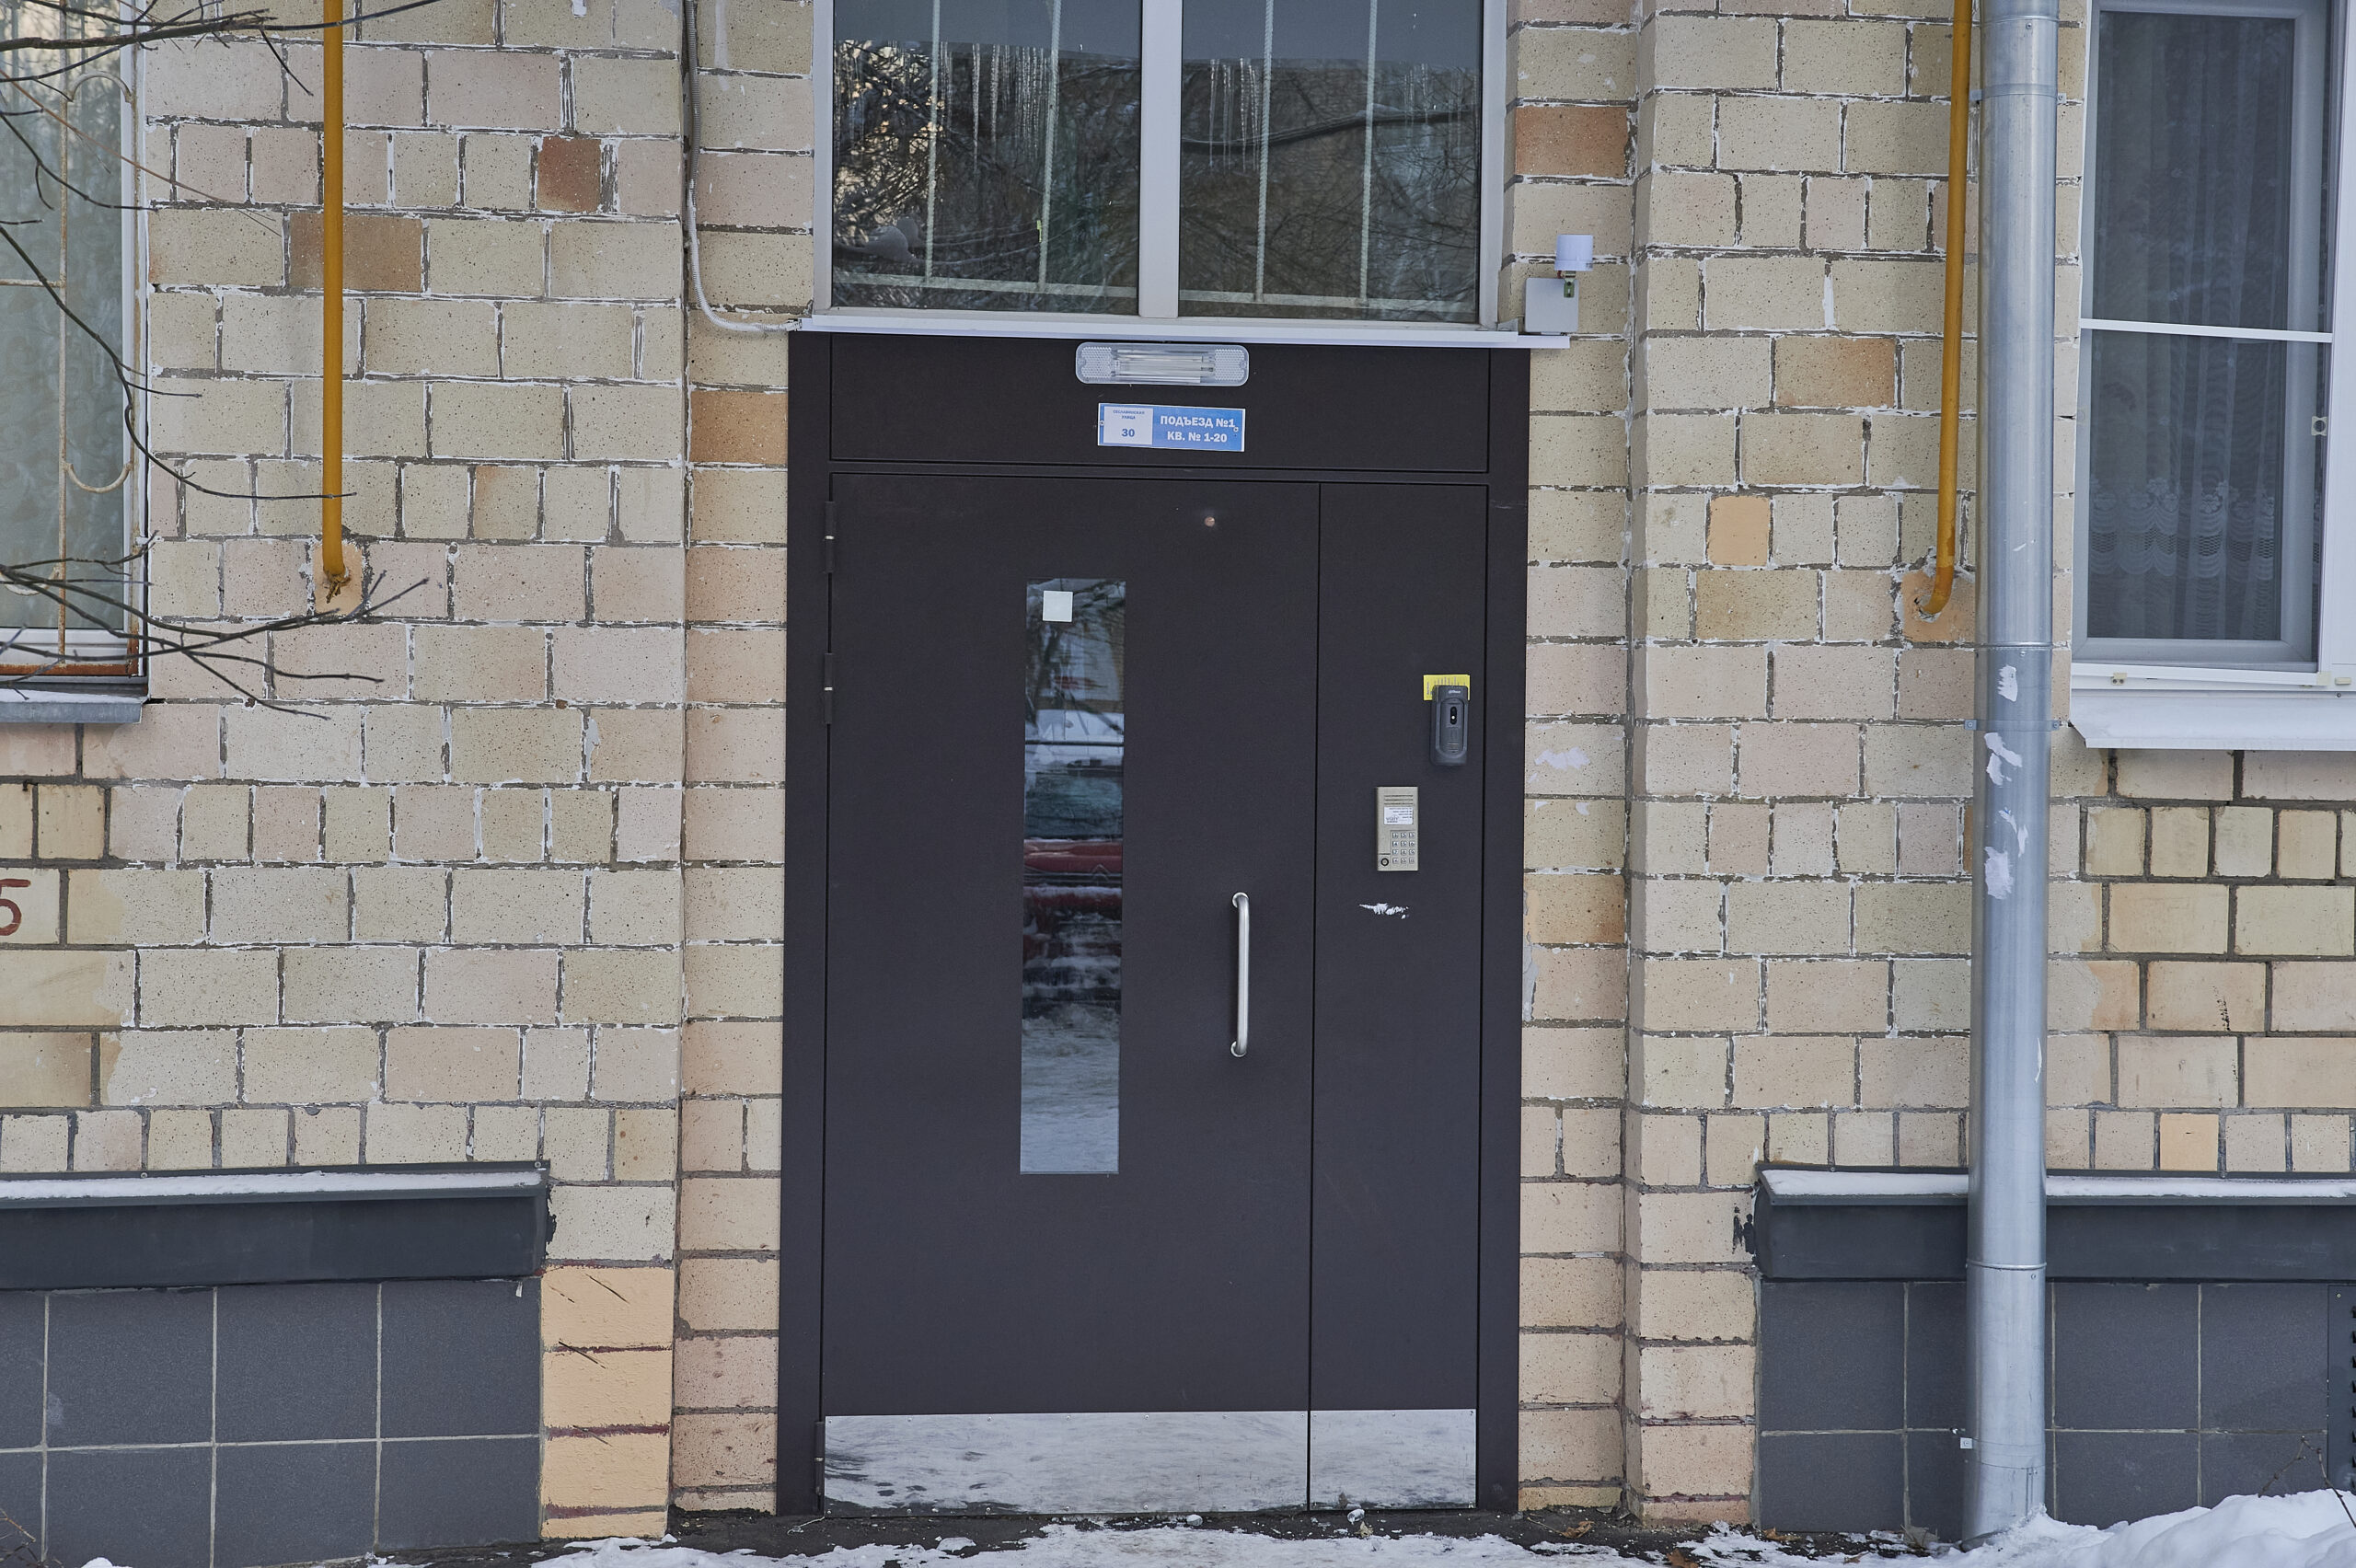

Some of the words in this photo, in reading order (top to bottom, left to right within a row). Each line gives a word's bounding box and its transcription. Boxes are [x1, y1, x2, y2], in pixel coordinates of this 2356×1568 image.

[1160, 415, 1214, 429] ПОДЪЕЗД
[1216, 418, 1236, 428] №1
[1121, 428, 1135, 437] 30
[1167, 431, 1185, 441] КВ.
[1188, 432, 1201, 442] №
[1204, 432, 1228, 443] 1-20
